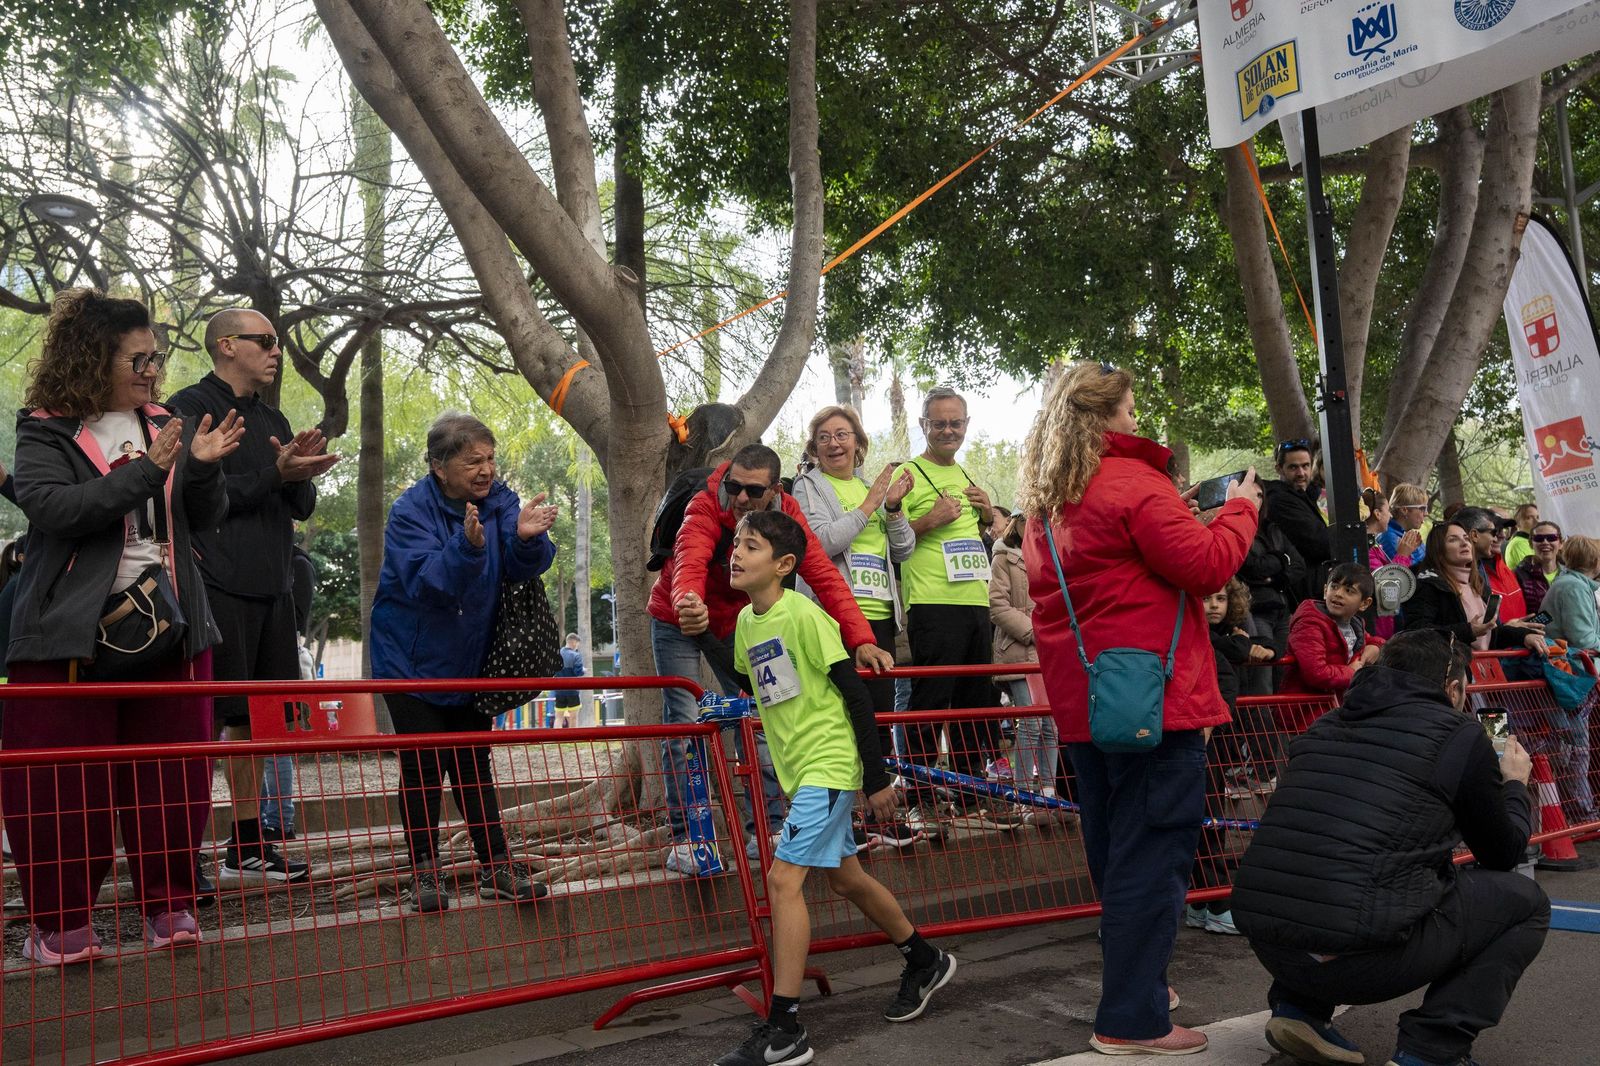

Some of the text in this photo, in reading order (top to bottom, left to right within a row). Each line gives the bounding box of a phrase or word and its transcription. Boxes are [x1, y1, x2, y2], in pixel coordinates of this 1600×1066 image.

[1222, 12, 1266, 49] ALMERÍA
[1455, 7, 1489, 30] UNIVERSITAS
[1236, 30, 1257, 50] CIUDAD
[1243, 48, 1287, 92] SOLAN
[1334, 43, 1418, 80] Compañía de María
[1246, 69, 1290, 105] DE CABRAS
[950, 554, 988, 570] 1689
[851, 569, 889, 589] 1690
[757, 664, 777, 690] 44
